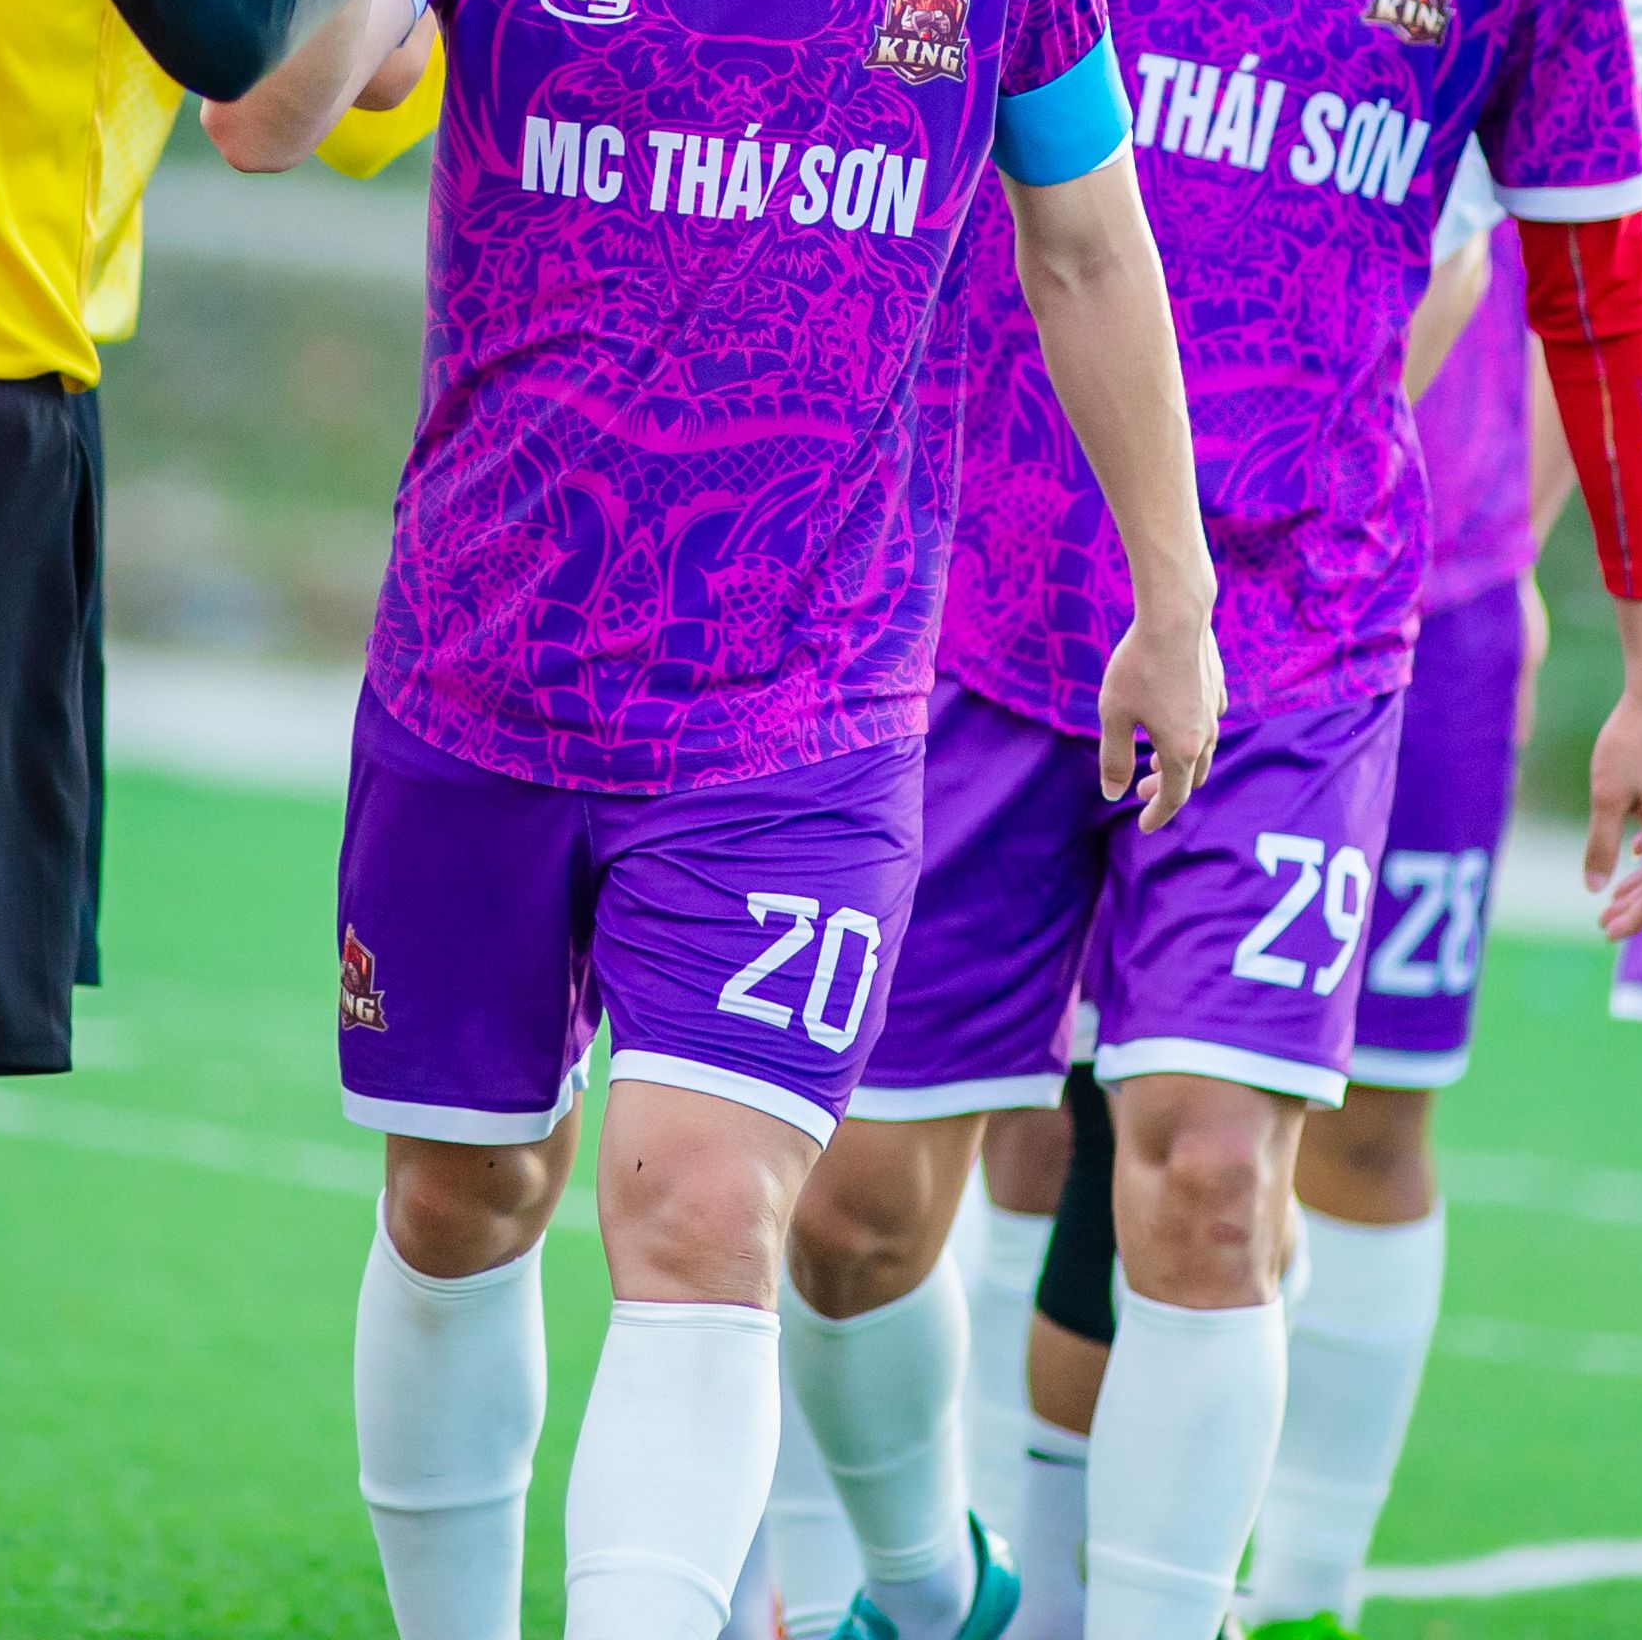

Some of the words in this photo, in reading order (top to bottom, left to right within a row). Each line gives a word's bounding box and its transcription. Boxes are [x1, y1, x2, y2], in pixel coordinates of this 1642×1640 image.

[876, 35, 961, 73] KING
[1135, 53, 1285, 171] THÁI
[1289, 91, 1430, 205] SƠN
[521, 115, 625, 203] MC
[648, 123, 791, 221] THÁI
[789, 143, 927, 238] SƠN
[717, 892, 881, 1053] 20
[1232, 832, 1372, 996] 29
[1368, 848, 1488, 996] 28
